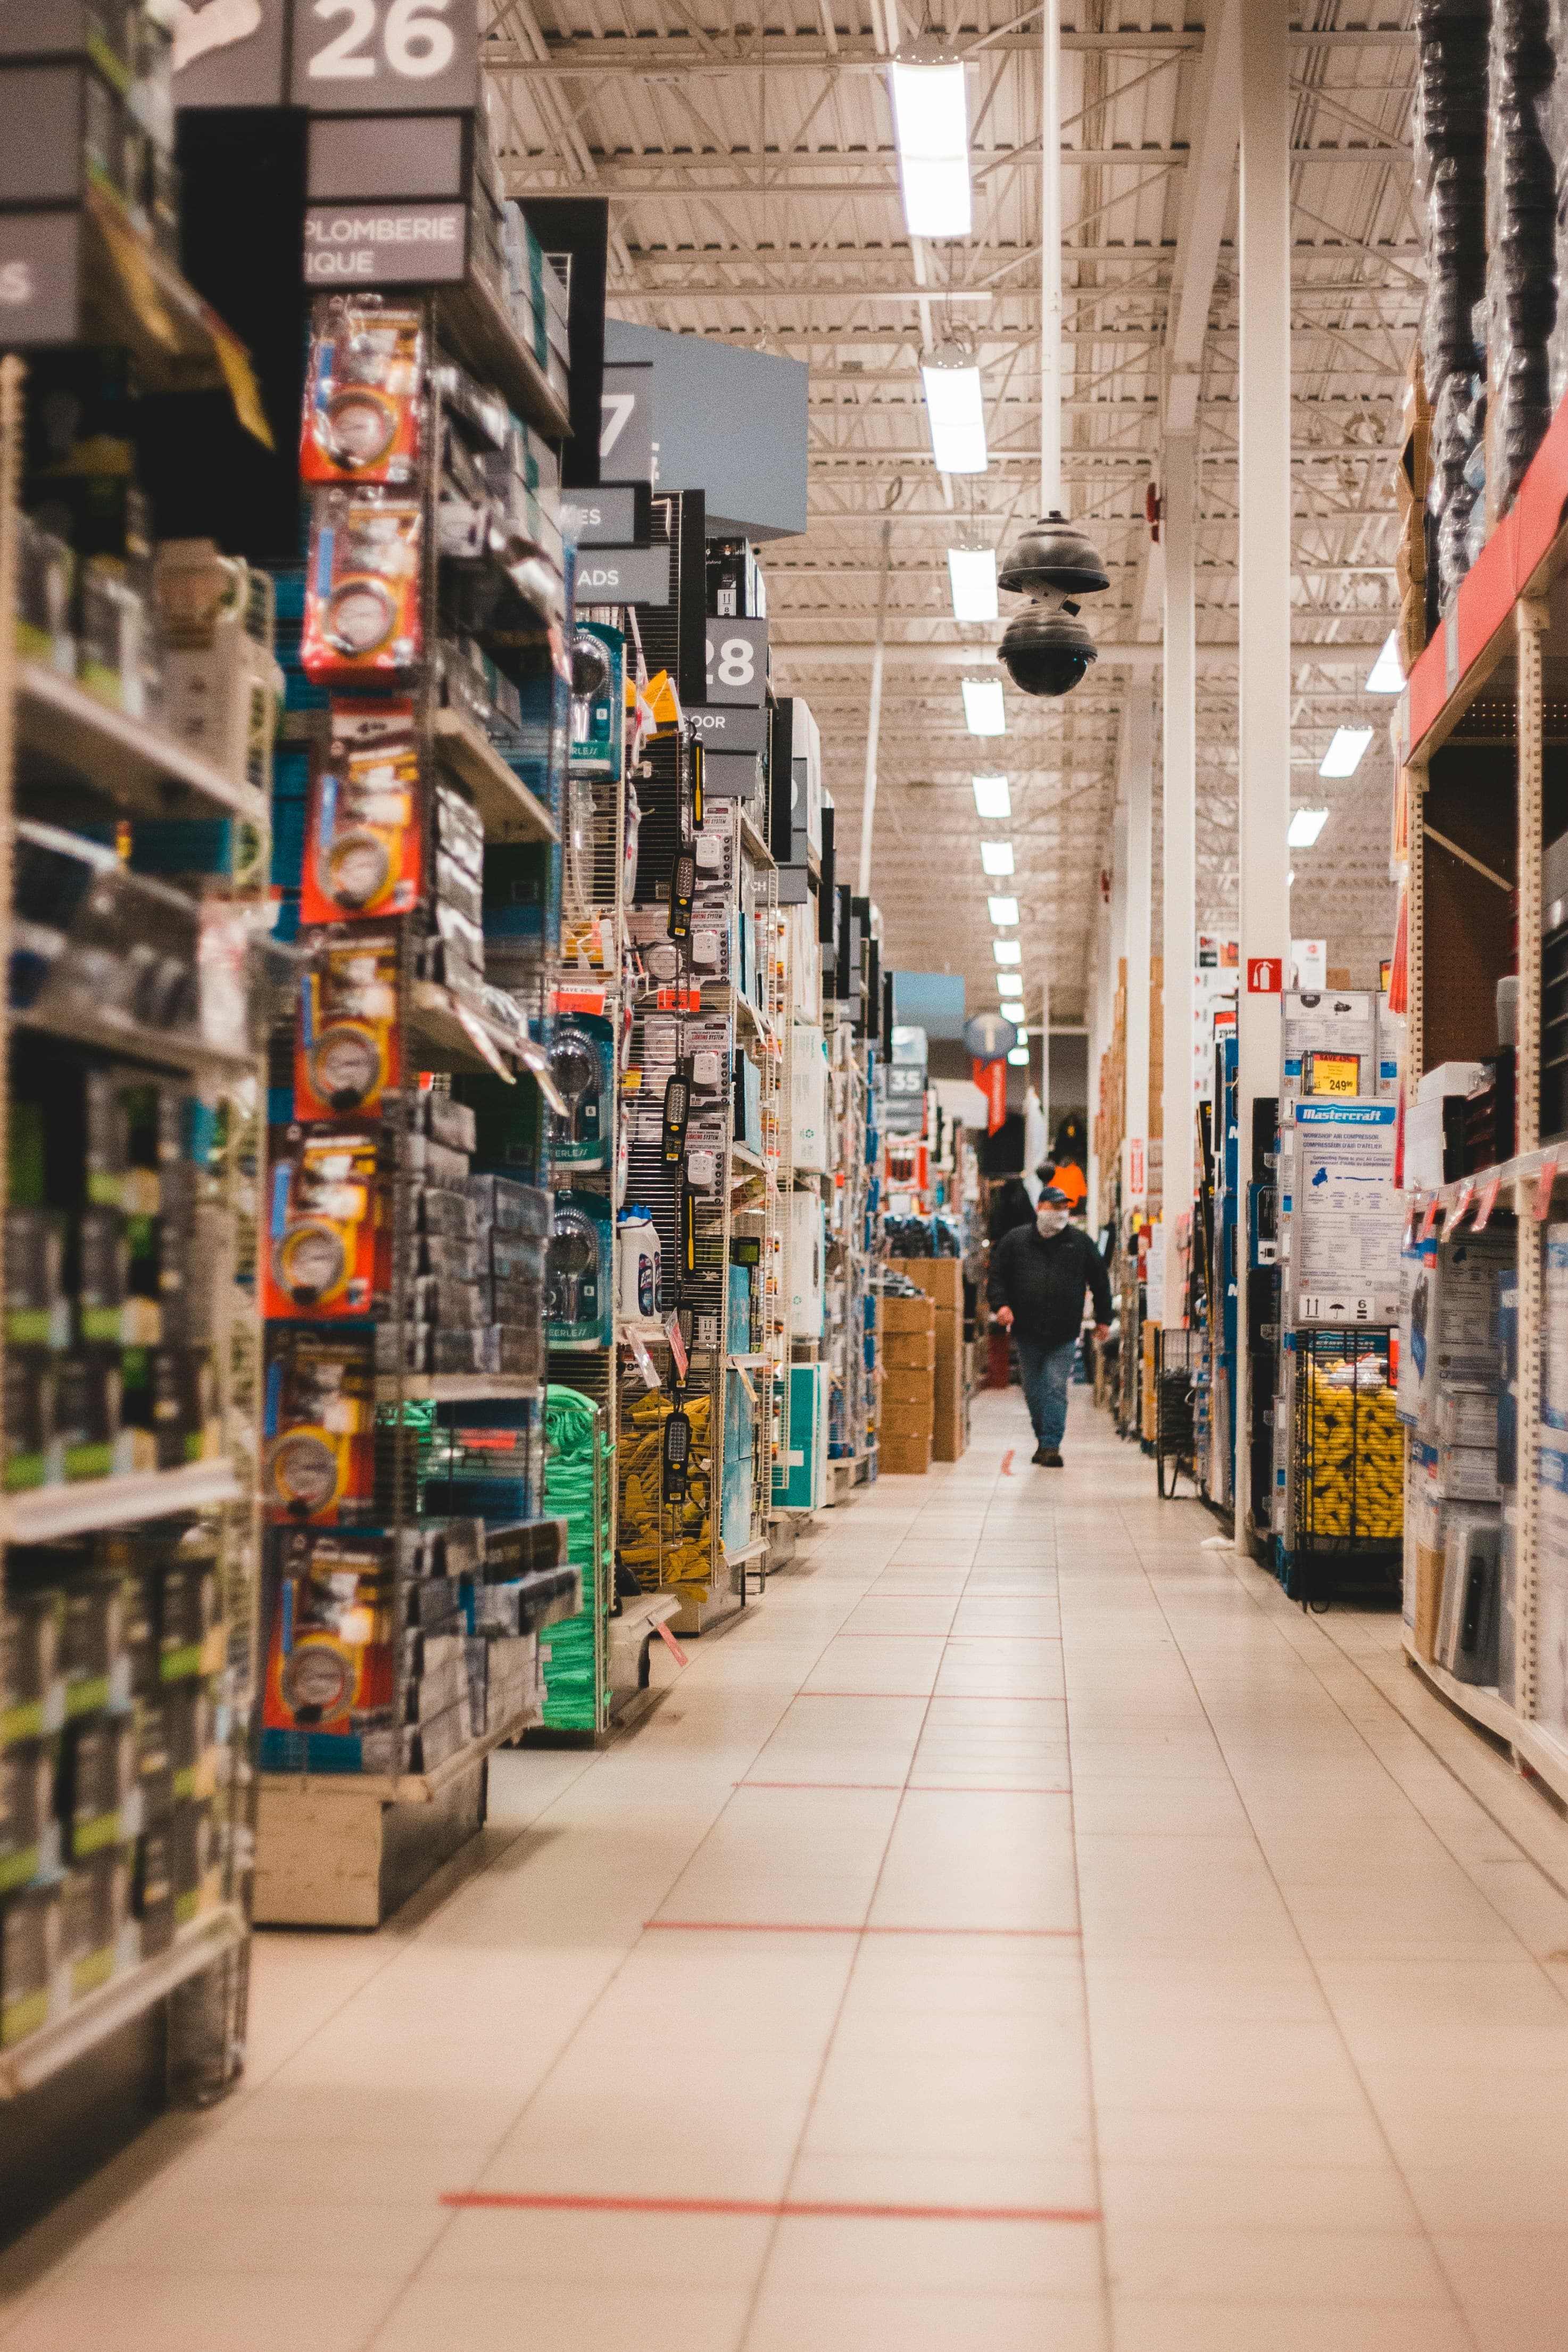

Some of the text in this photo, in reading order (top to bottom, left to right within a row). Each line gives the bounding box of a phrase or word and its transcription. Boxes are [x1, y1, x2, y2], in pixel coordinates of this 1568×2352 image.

[309, 0, 455, 78] 26
[305, 218, 456, 242] PLOMBERIE
[577, 570, 619, 586] ADS
[706, 639, 754, 686] 8
[892, 1070, 921, 1092] 35
[1303, 1109, 1381, 1121] Mastercraft
[1358, 1299, 1367, 1308] 6
